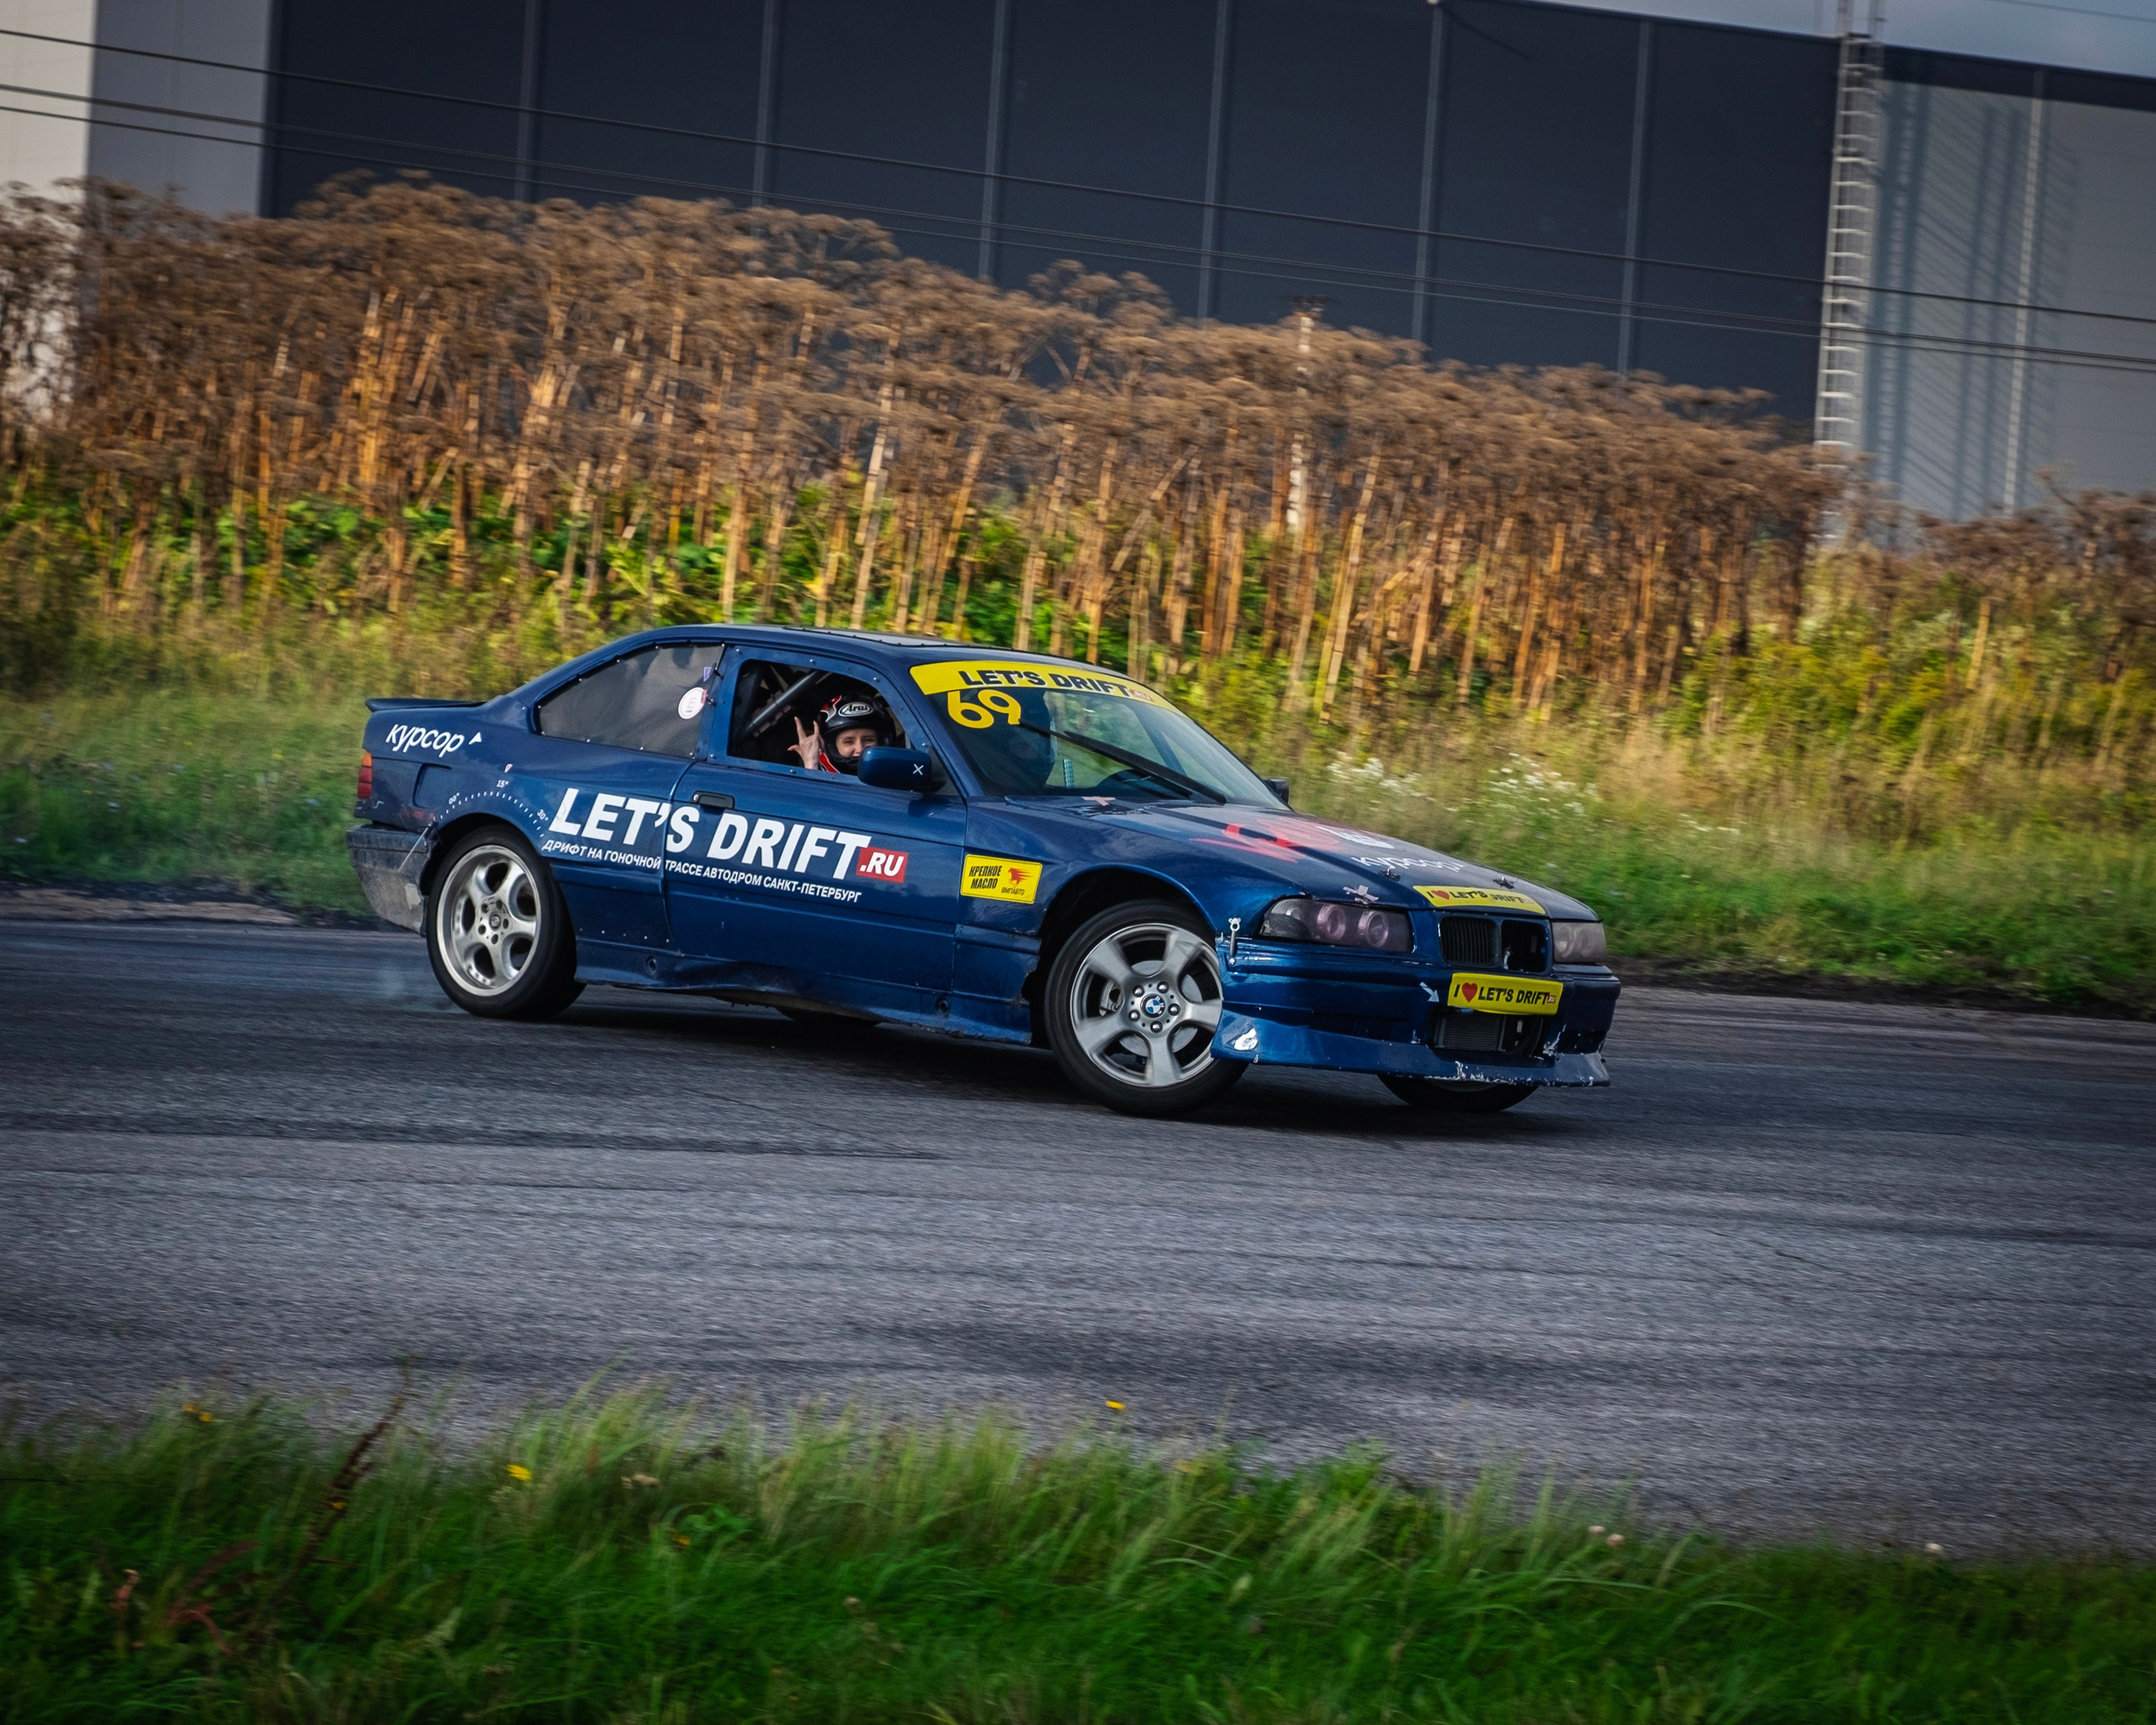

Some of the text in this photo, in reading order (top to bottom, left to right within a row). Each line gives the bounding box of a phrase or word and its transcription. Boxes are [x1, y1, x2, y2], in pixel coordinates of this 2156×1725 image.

[958, 670, 1046, 686] LET'S
[844, 703, 868, 713] Arai
[947, 689, 1022, 729] 69
[548, 788, 700, 853] LET'S
[542, 840, 862, 903] ДРИФТ НА ГОНОЧНОЙ ТРАССЕ АВТОДРОМ САНКТ-ПЕТЕРБУРГ
[969, 865, 1002, 877] КРЕПКОЕ
[970, 878, 998, 889] МАСЛО
[1449, 890, 1488, 900] LET'S
[1454, 984, 1460, 997] I
[1478, 986, 1513, 1003] LET'S
